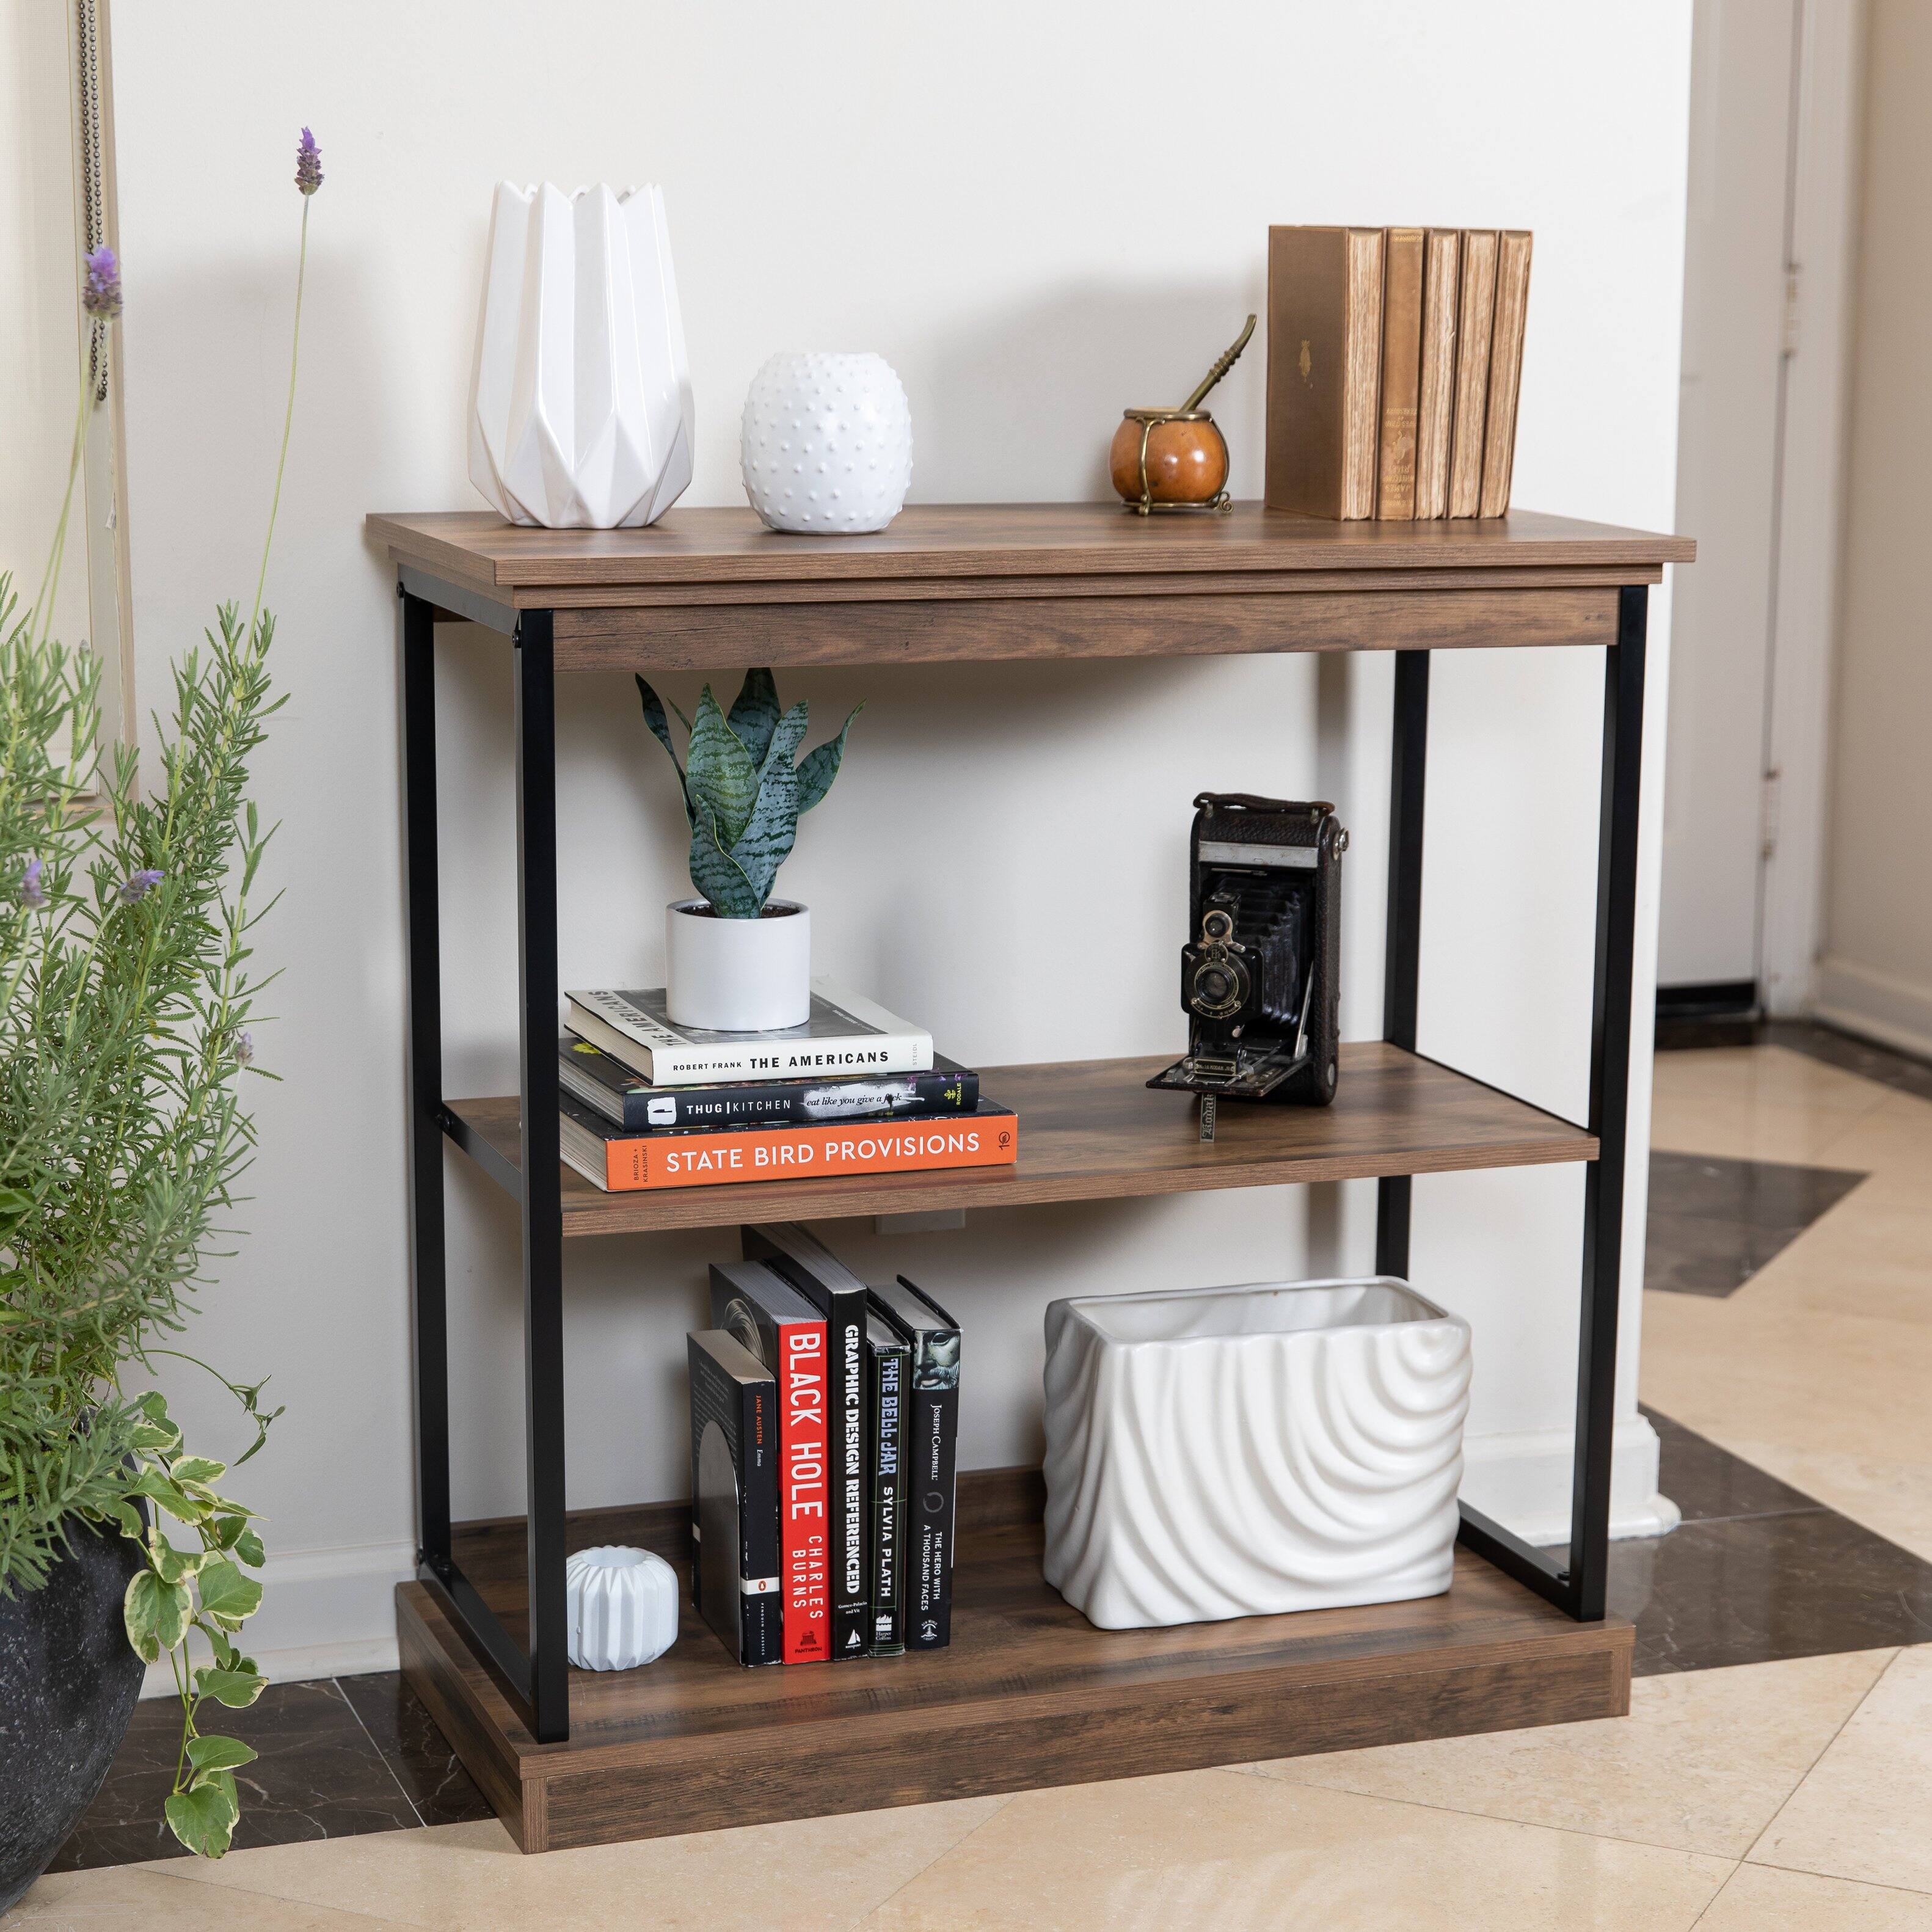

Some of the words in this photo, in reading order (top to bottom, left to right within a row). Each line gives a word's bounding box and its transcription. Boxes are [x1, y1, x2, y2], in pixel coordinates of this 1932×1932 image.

[588, 991, 664, 1032] AMERICANS
[651, 1034, 687, 1046] THE
[750, 1057, 779, 1069] THE
[789, 1051, 889, 1067] AMERICANS
[687, 1103, 722, 1115] THUG
[733, 1099, 791, 1112] KITCHEN
[822, 1097, 837, 1106] like
[838, 1098, 856, 1107] you
[856, 1096, 875, 1105] give
[881, 1093, 902, 1105] fck
[666, 1148, 743, 1172] STATE
[754, 1144, 814, 1167] BIRD
[825, 1132, 980, 1161] PROVISIONS
[789, 1333, 822, 1427] BLACK
[845, 1324, 859, 1405] GRAPHIC
[882, 1358, 899, 1393] THE
[881, 1396, 899, 1438] BELL
[845, 1409, 859, 1475] DESIGN
[878, 1442, 897, 1476] JAR
[790, 1442, 823, 1520] HOLE
[846, 1478, 860, 1594] REFERENCED
[882, 1487, 894, 1542] SYLVIA
[792, 1549, 807, 1608] BURNS
[808, 1535, 823, 1619] CHARLES
[881, 1548, 892, 1597] PLATH
[922, 1533, 931, 1582] THOUSAND
